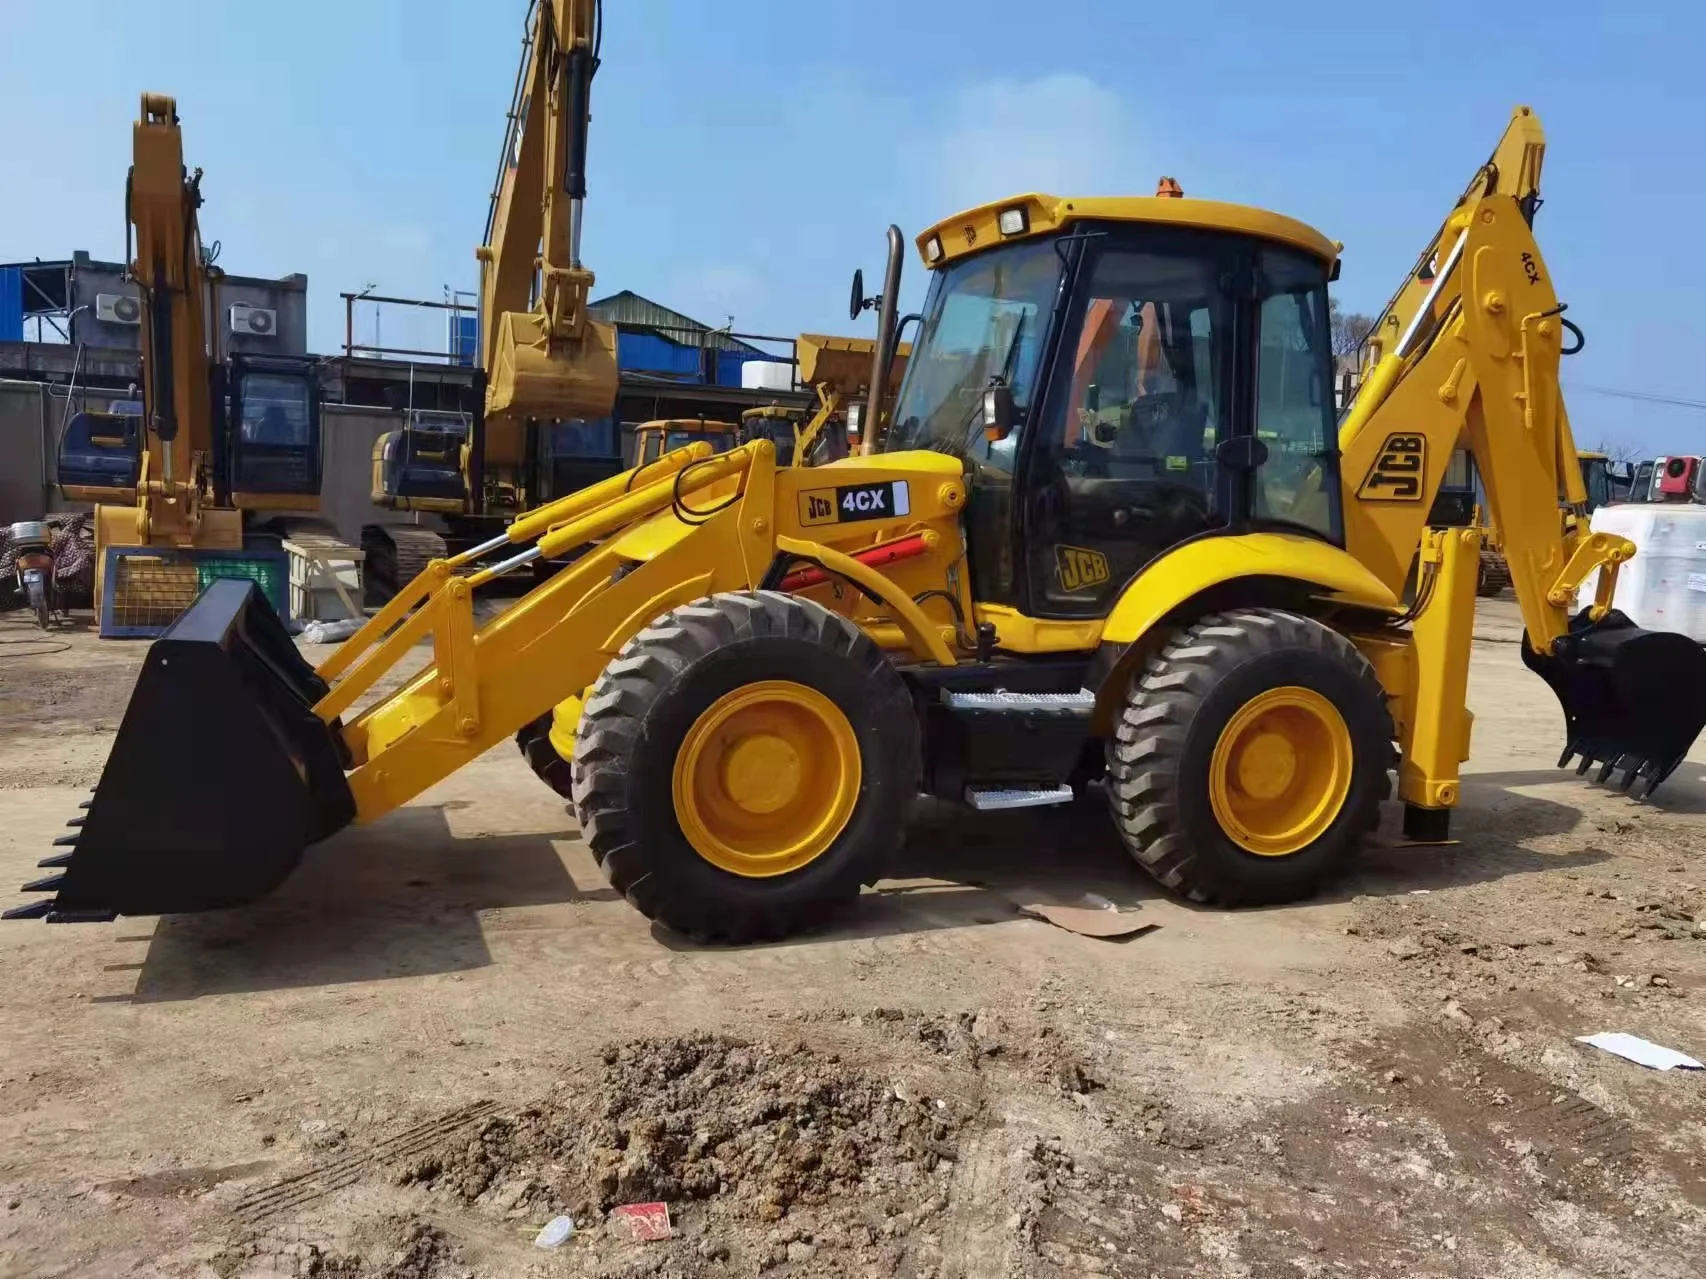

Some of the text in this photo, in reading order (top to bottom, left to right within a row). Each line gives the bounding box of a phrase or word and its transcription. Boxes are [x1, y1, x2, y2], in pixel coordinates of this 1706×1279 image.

[1521, 252, 1541, 286] 4CX
[1367, 437, 1422, 496] JCB
[808, 489, 885, 519] JCB 4CX
[1062, 549, 1107, 589] JCB
